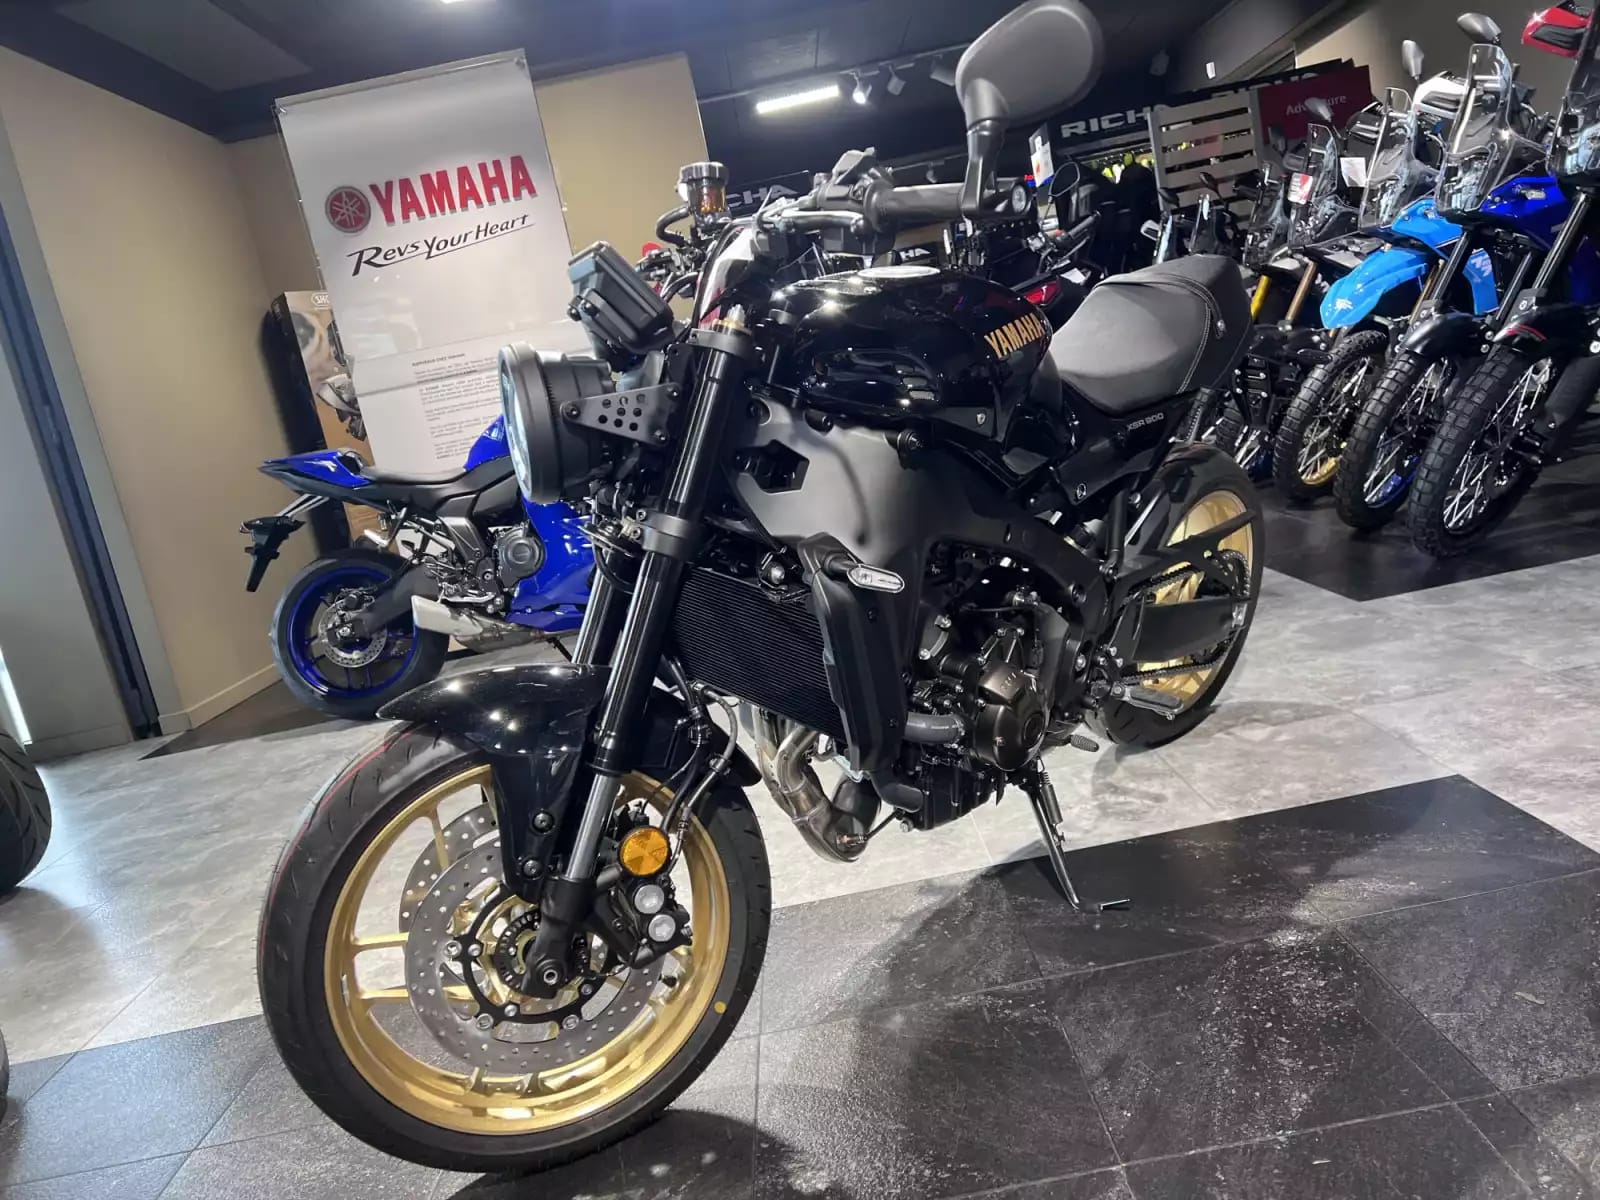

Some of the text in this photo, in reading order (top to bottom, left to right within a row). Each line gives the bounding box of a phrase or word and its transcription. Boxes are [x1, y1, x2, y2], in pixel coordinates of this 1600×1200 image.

[1061, 104, 1168, 138] RICH
[1285, 94, 1347, 117] Advure
[368, 155, 538, 227] YAMAHA
[347, 213, 530, 277] Revs Your Heart
[983, 312, 1046, 360] YAMAHA
[1126, 419, 1146, 431] XSR
